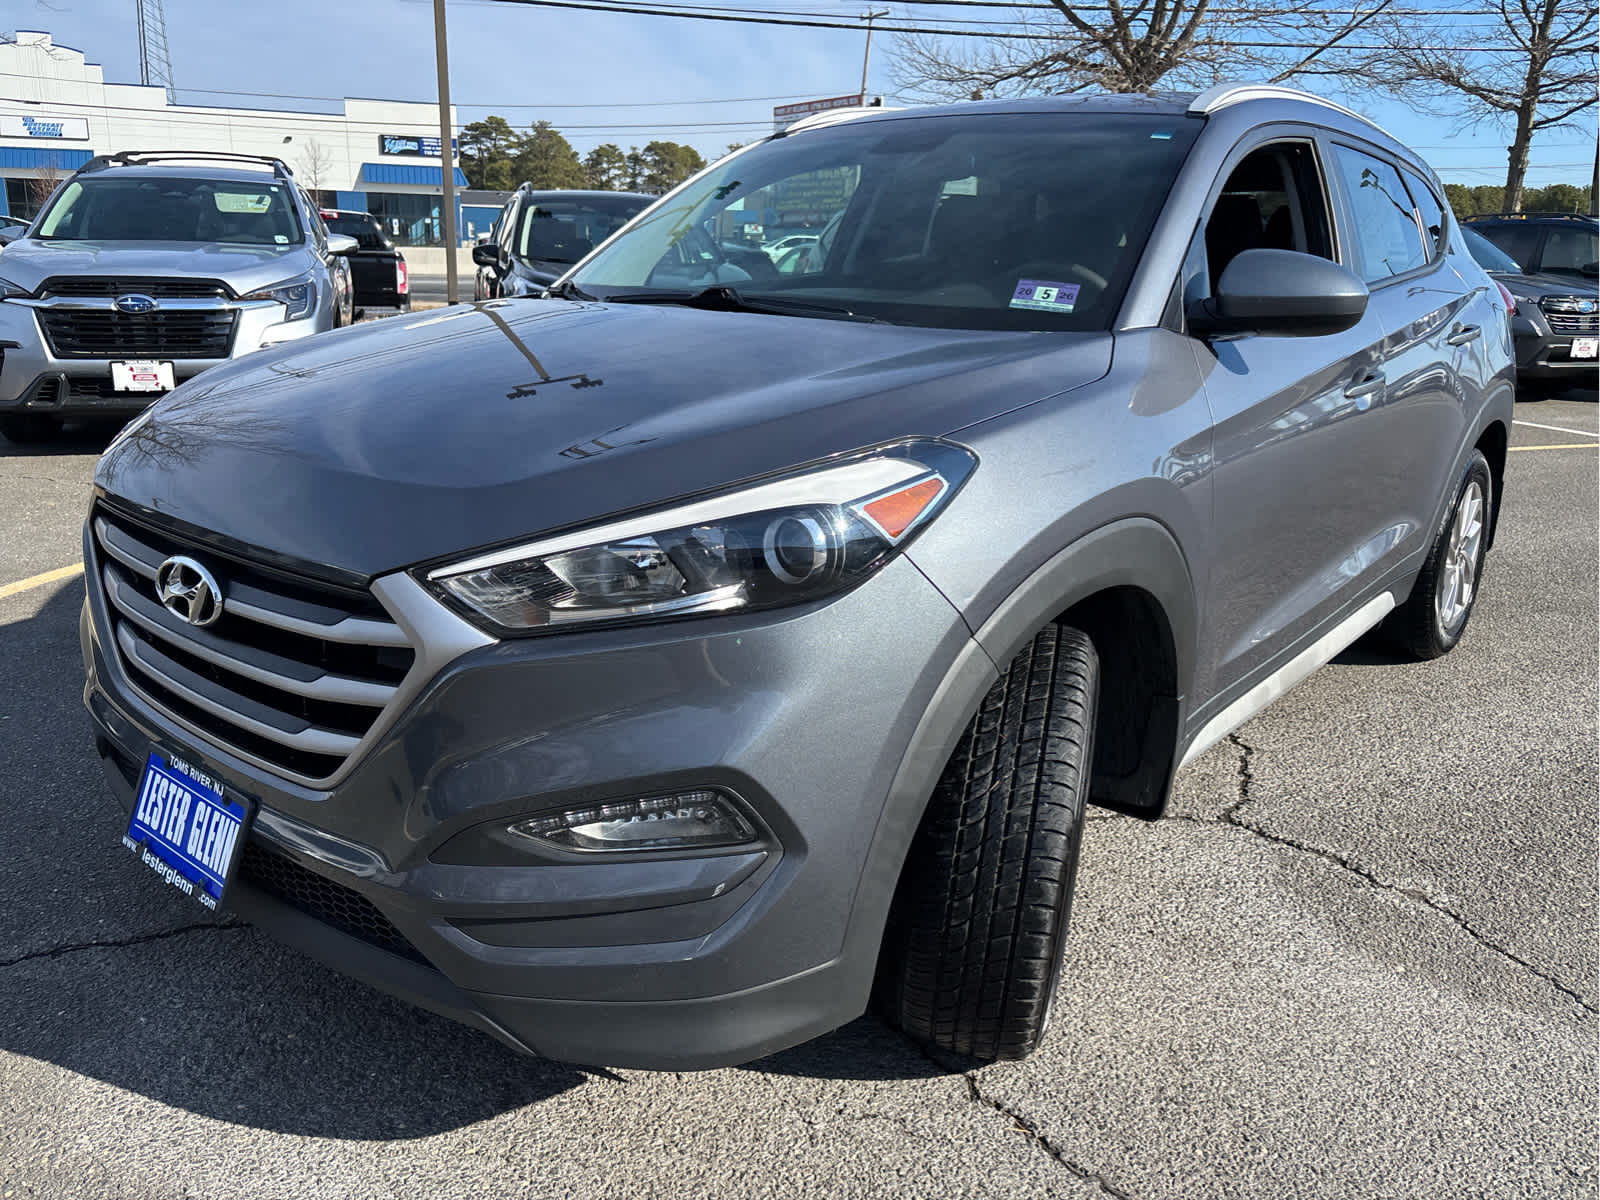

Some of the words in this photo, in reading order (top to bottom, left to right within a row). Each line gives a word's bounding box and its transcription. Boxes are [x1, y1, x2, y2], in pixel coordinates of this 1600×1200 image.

[1018, 287, 1032, 295] 20
[1041, 289, 1053, 300] 5
[1058, 291, 1073, 300] 26
[169, 755, 189, 776] TOMS
[190, 767, 212, 790] RIVER,
[213, 780, 225, 796] NJ
[136, 769, 192, 848] LESTER
[187, 801, 240, 879] GLENN
[142, 848, 193, 896] lesterglenn
